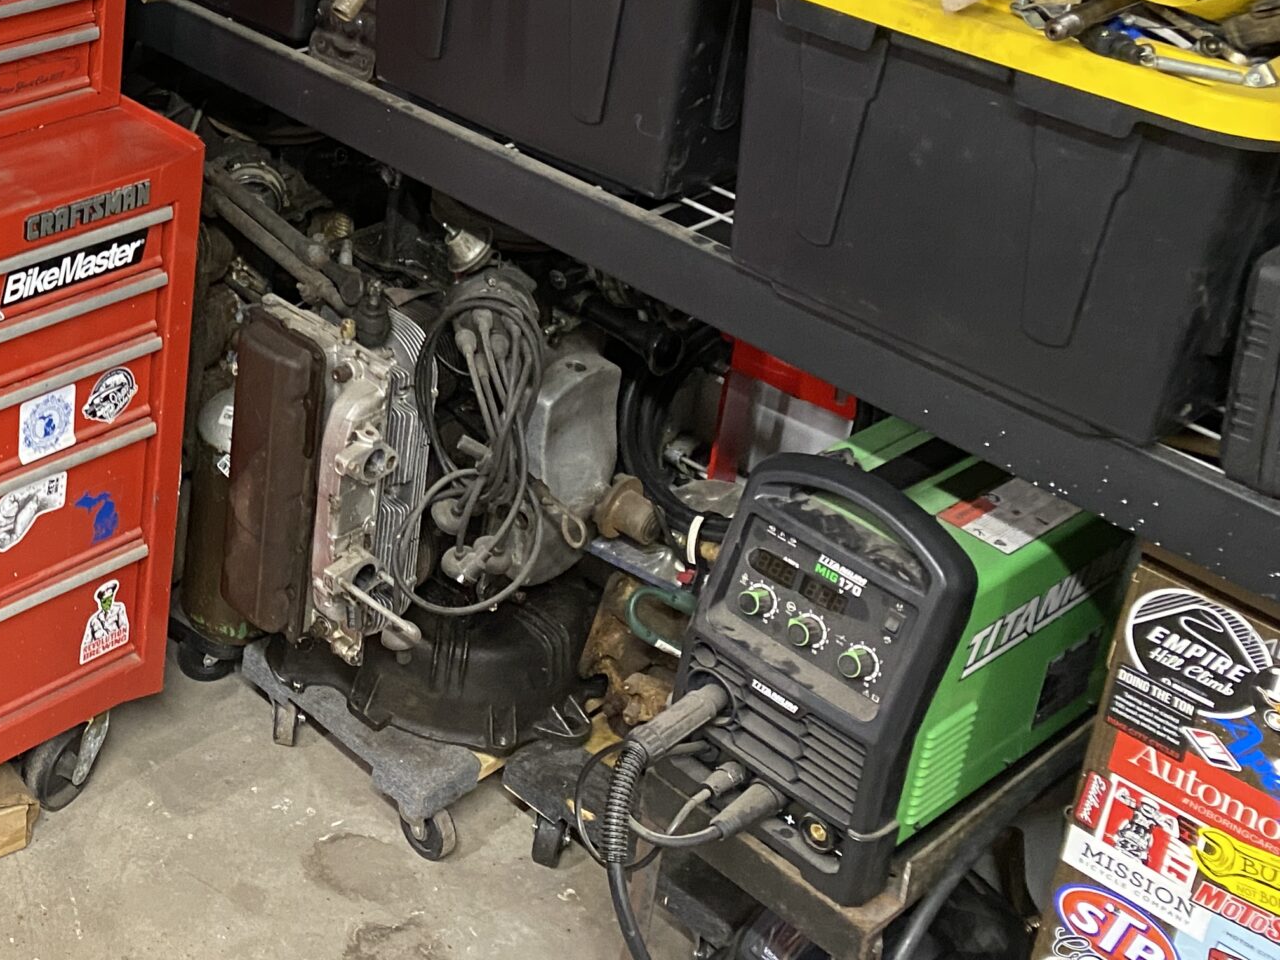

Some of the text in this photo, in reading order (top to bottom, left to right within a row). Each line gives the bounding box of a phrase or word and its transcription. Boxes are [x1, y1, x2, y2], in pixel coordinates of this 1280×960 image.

[24, 179, 151, 241] CRAFTSMAN
[3, 239, 144, 305] BikeMaster
[815, 563, 863, 598] MIG 170
[818, 553, 868, 588] TITANIUM
[1146, 625, 1252, 683] EMPIRE
[1149, 646, 1186, 671] Hill
[1183, 665, 1235, 696] Climb
[752, 678, 799, 714] TITANIUM
[1116, 668, 1151, 693] DOING
[1150, 684, 1172, 705] THE
[1172, 696, 1195, 717] TON
[1079, 857, 1191, 926] BICYCLE COMPANY
[1081, 842, 1196, 919] MISSION
